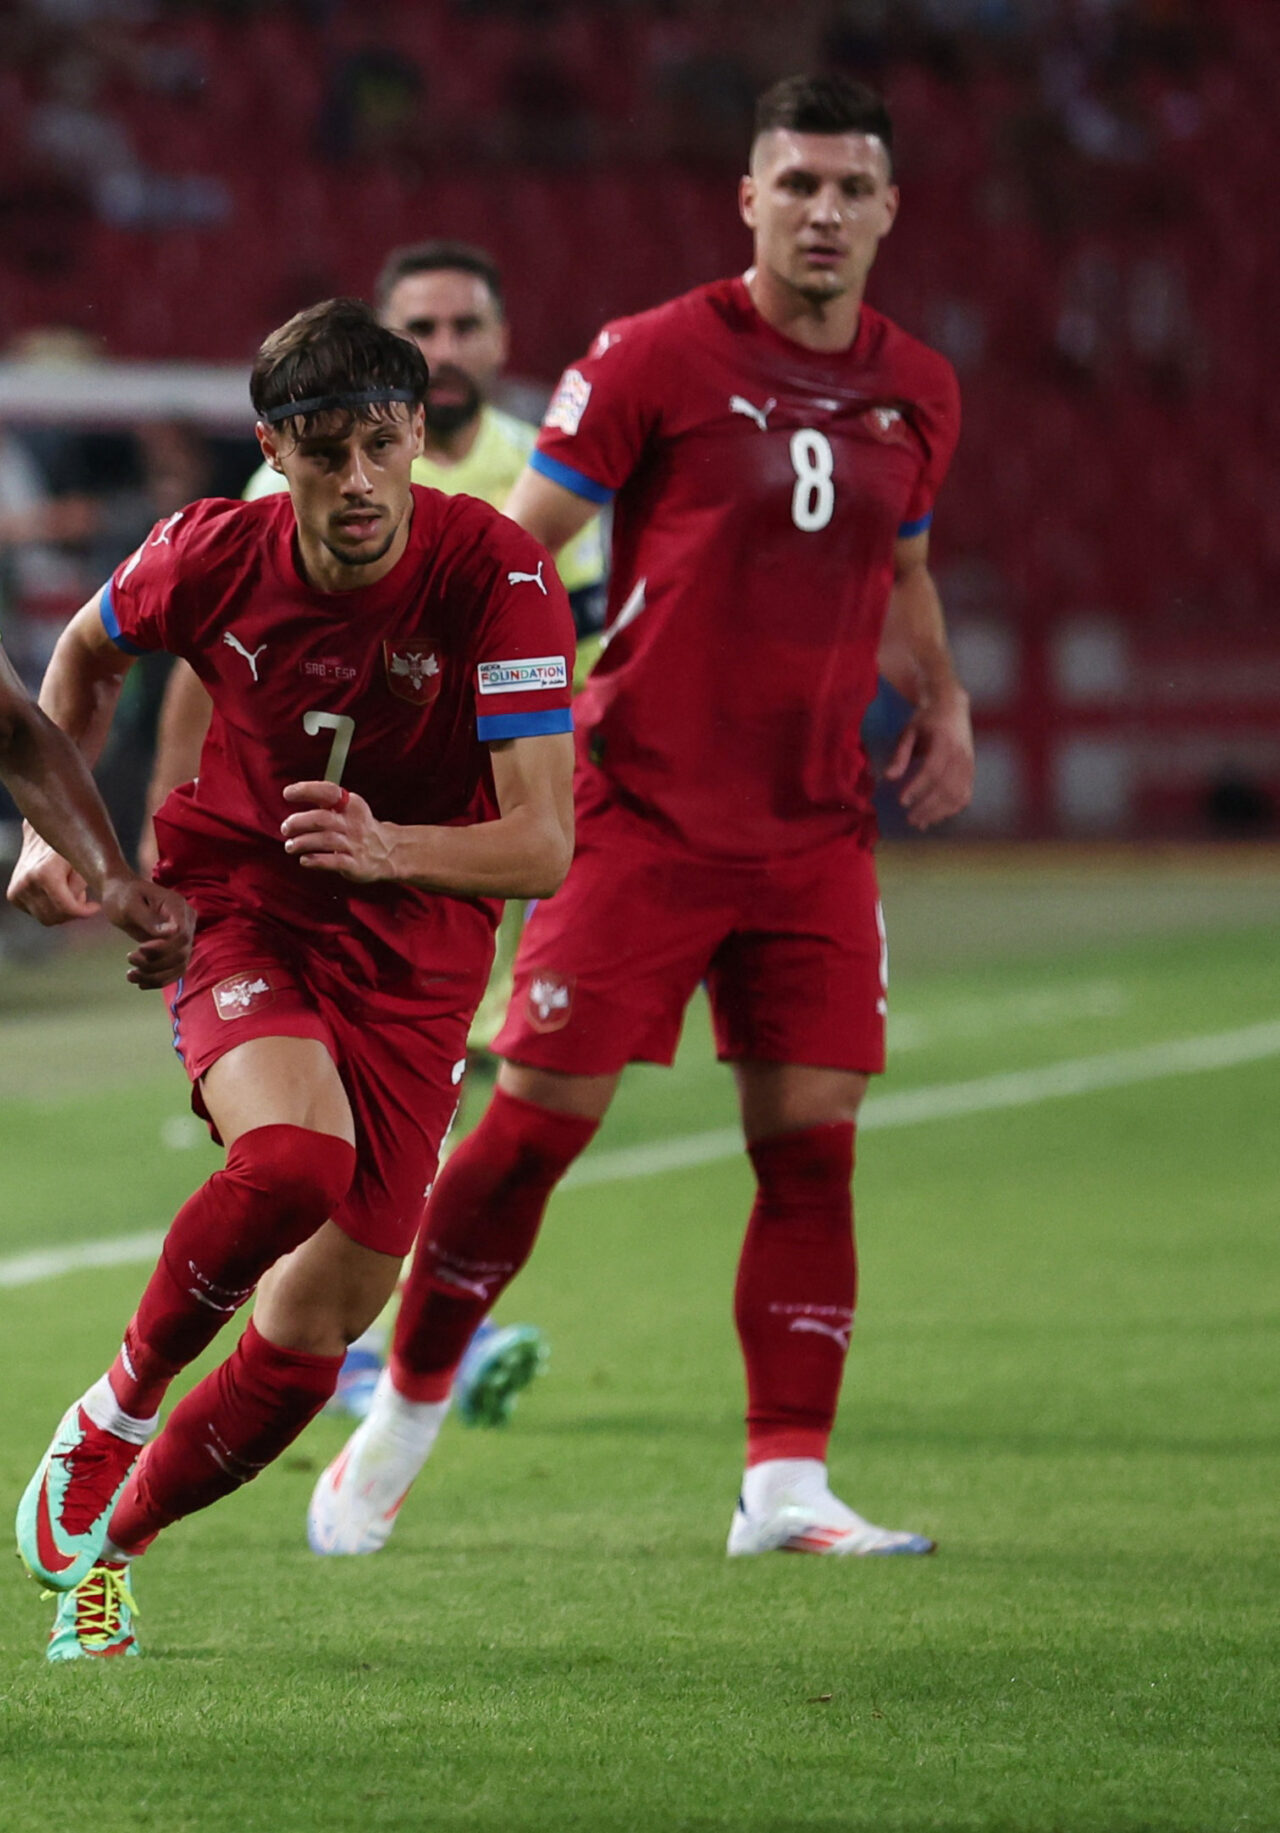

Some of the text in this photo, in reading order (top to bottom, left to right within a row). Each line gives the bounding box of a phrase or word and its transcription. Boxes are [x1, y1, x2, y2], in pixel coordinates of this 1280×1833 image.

[789, 428, 835, 533] 8
[335, 666, 357, 680] ESP
[481, 666, 564, 683] FOUNDATION
[303, 710, 355, 786] 7
